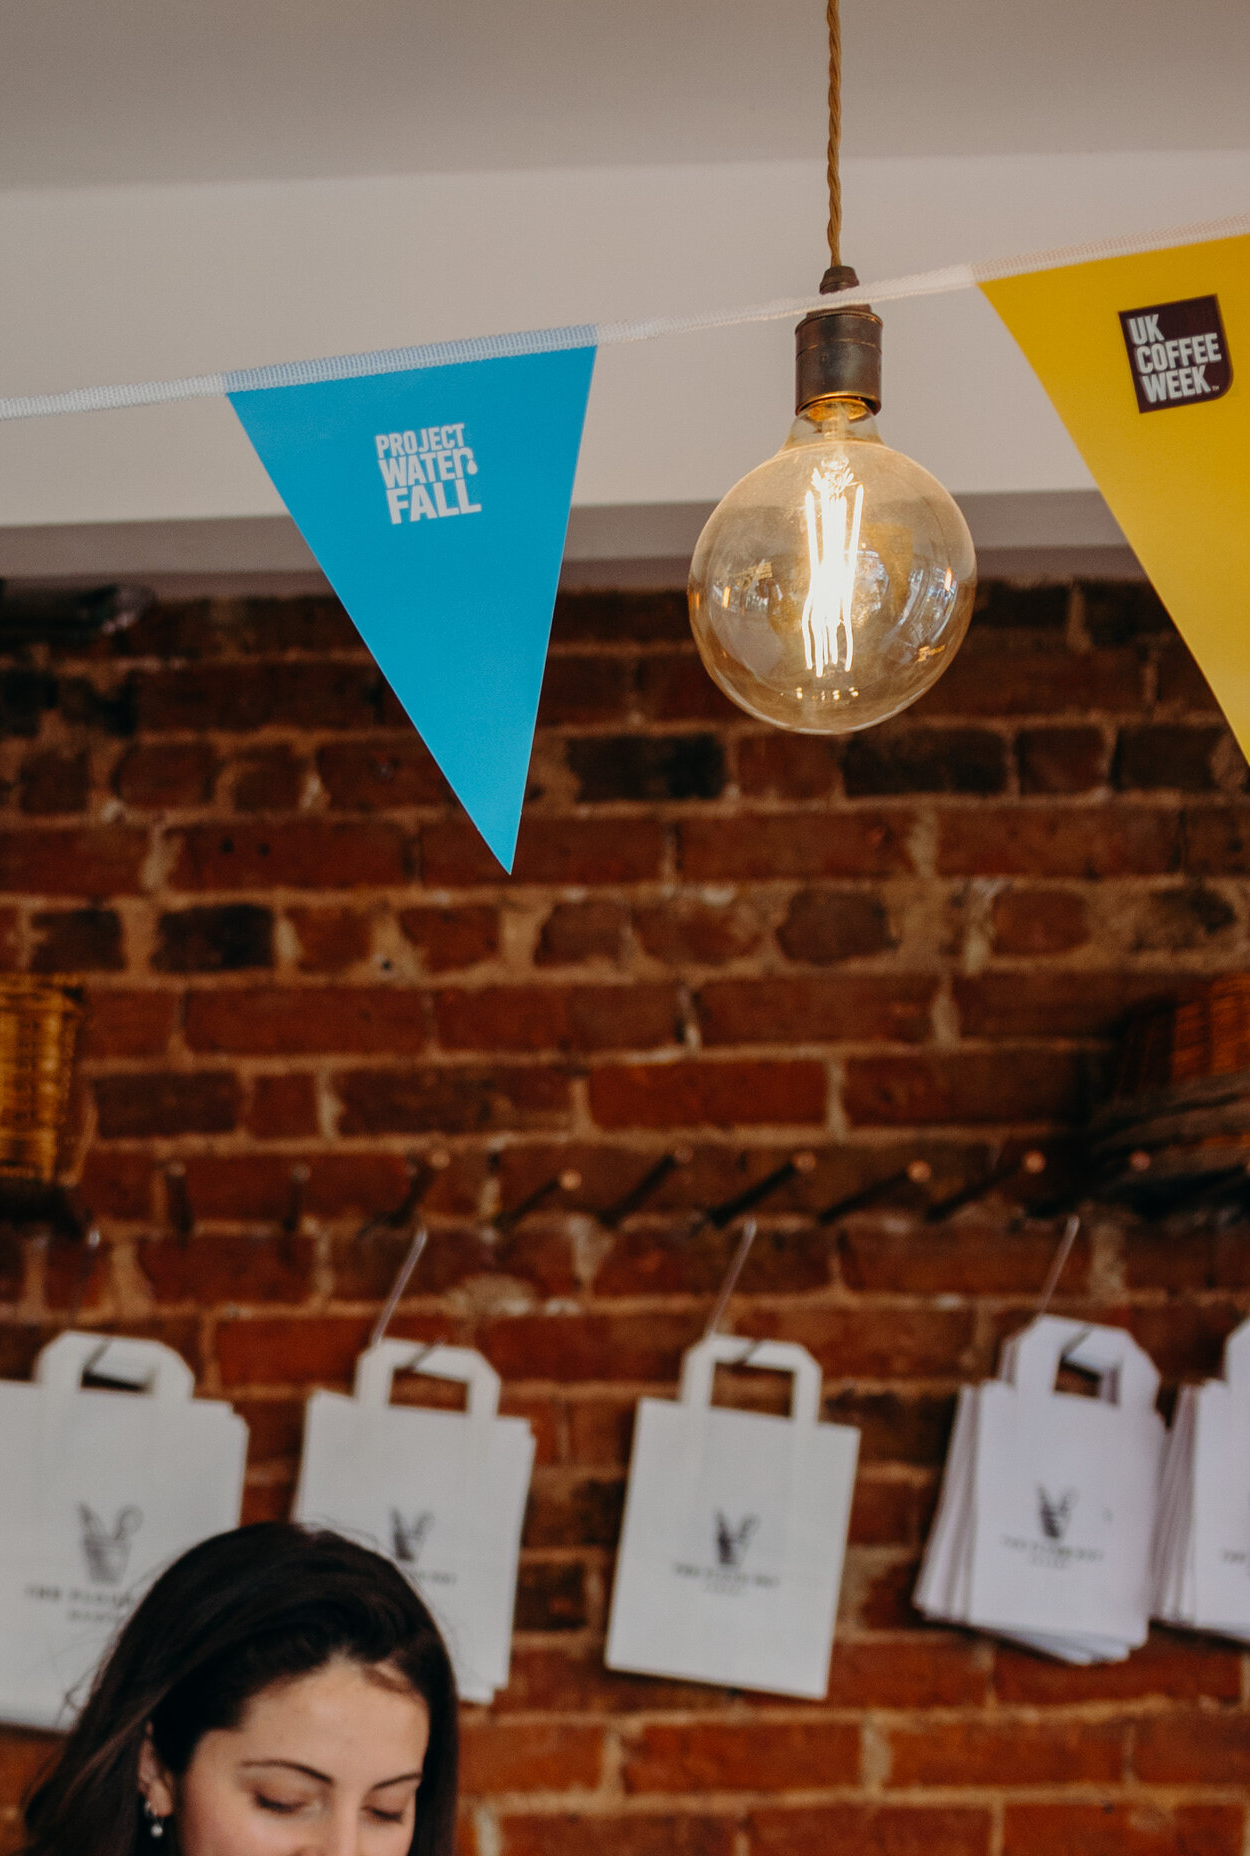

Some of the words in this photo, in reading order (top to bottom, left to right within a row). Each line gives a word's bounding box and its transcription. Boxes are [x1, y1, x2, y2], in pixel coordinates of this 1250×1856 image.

[1128, 313, 1166, 345] UK
[1135, 332, 1222, 375] COFFEE
[374, 422, 465, 459] PROJECT
[385, 478, 483, 525] FALL
